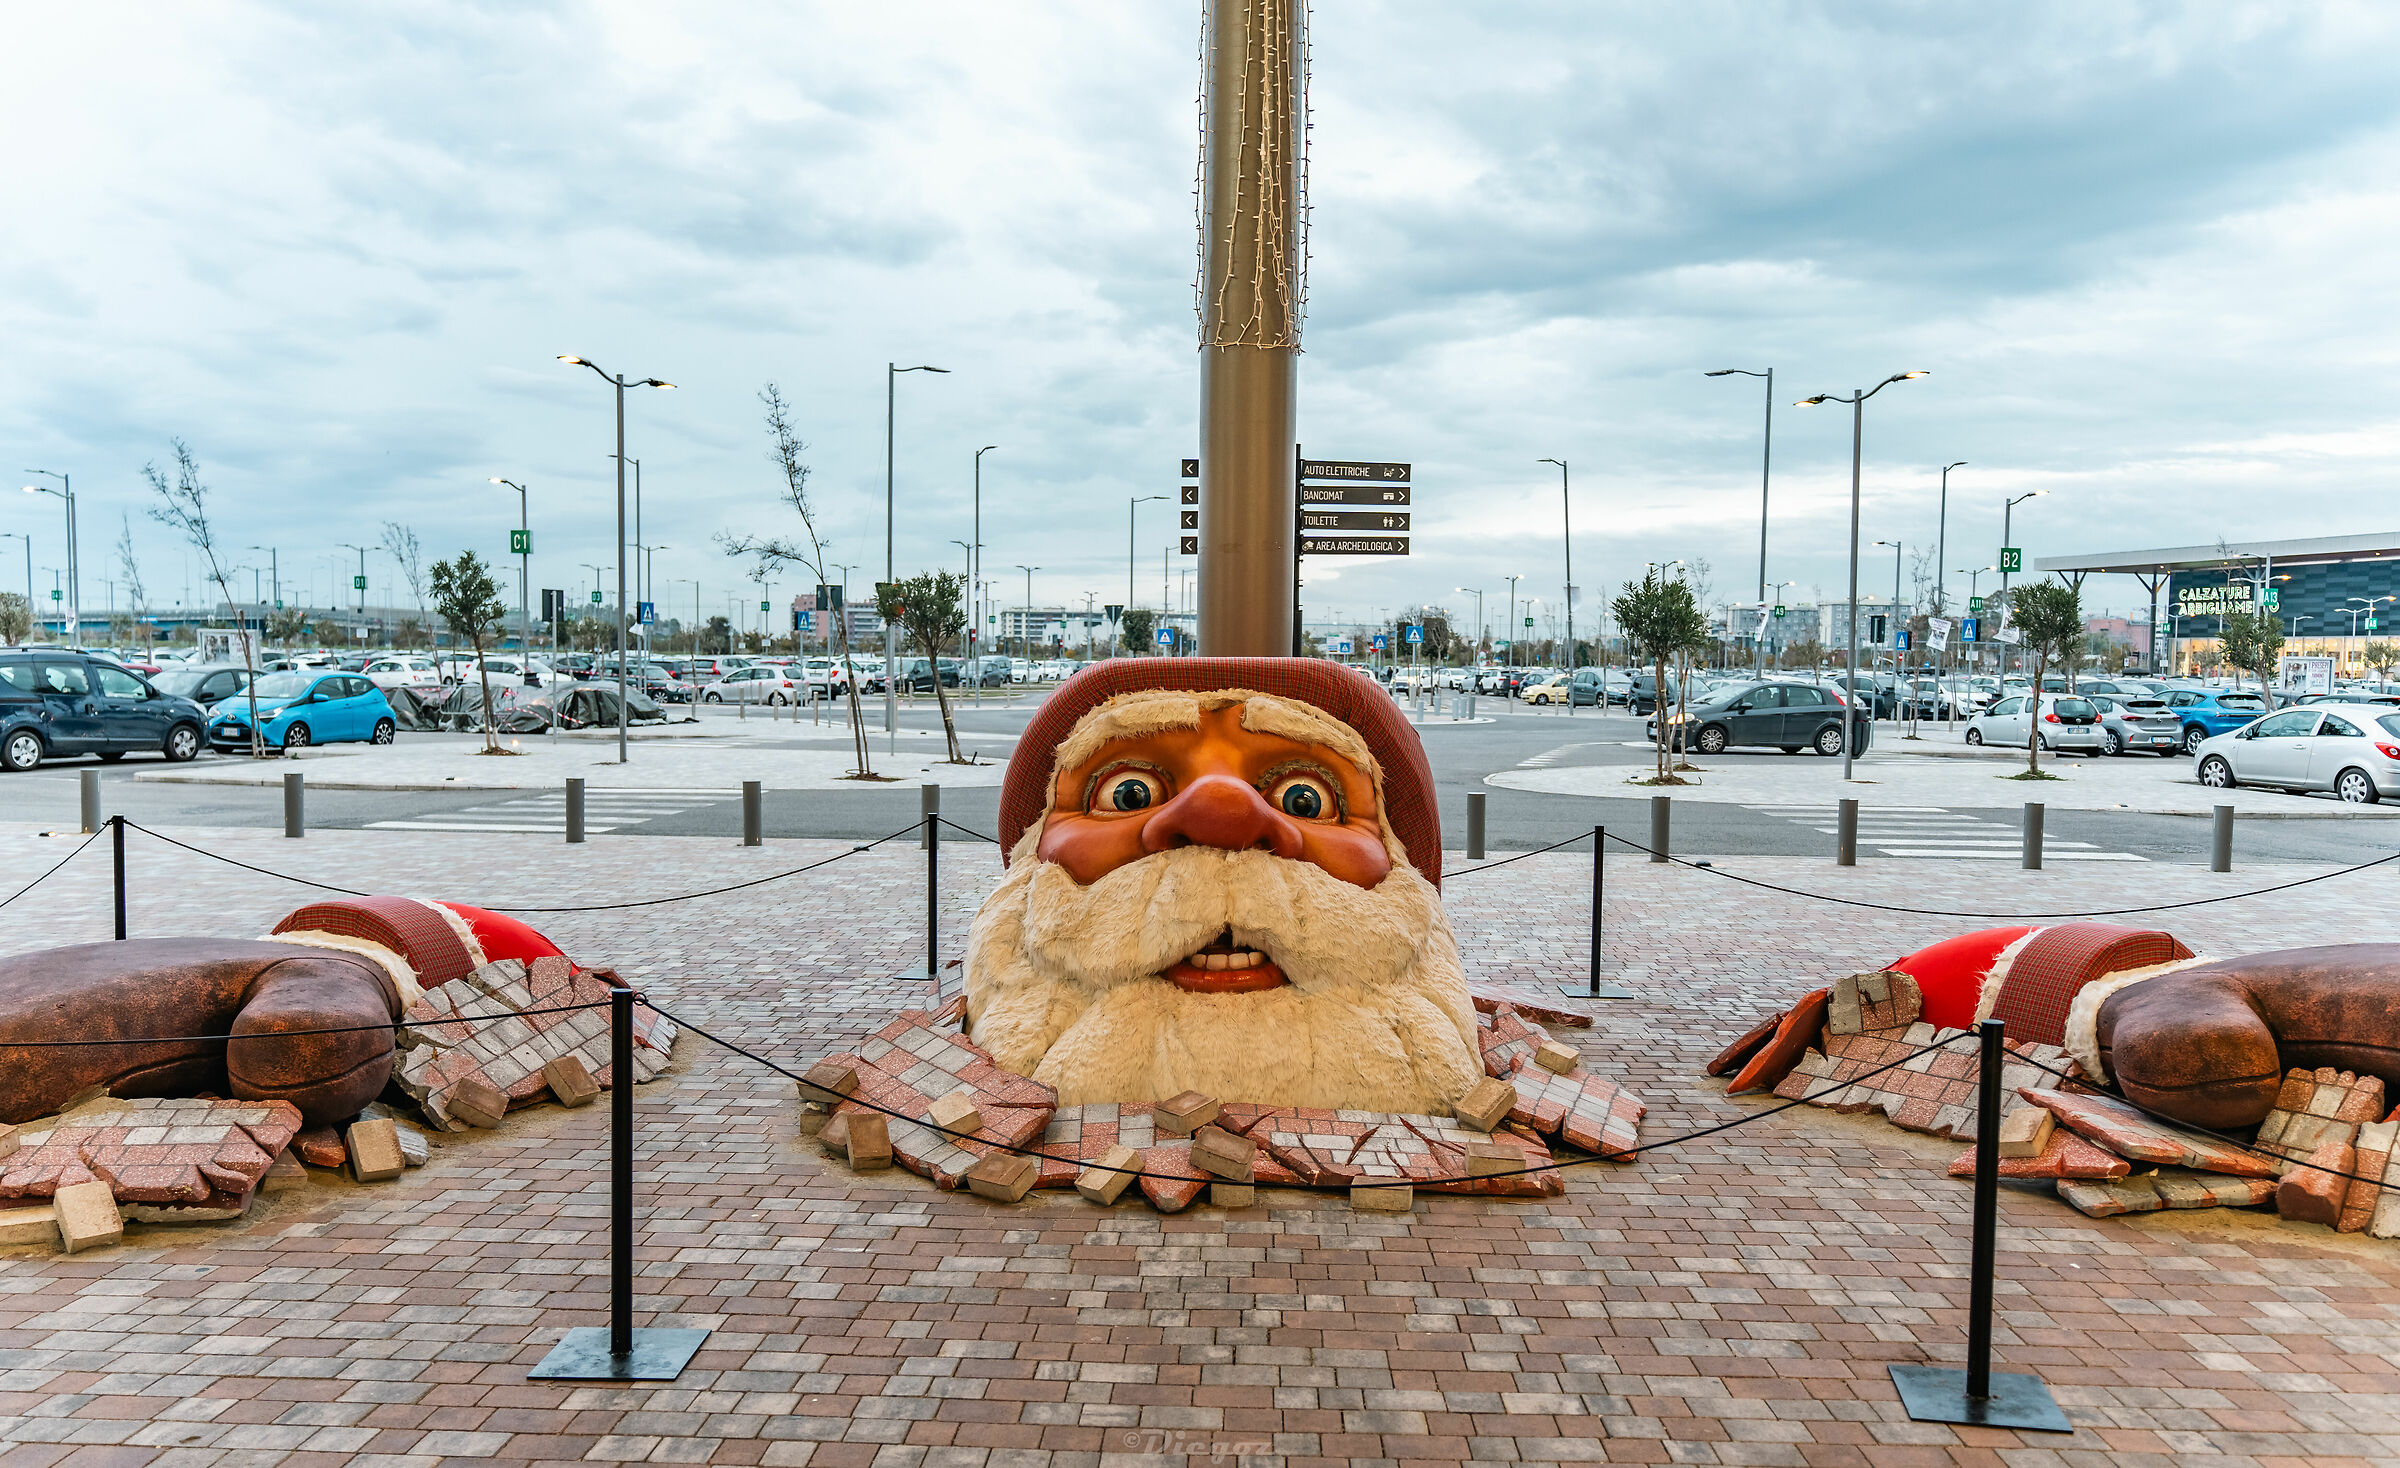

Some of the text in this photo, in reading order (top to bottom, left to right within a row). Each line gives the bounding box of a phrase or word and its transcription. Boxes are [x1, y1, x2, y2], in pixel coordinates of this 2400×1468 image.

[1304, 465, 1371, 477] AUTO ELETTRICHE
[1303, 490, 1344, 501] BANCOMAT
[1303, 515, 1339, 526] TOILETTE
[513, 533, 527, 550] C1
[1315, 541, 1393, 552] AREA ARCHEOLOGICA
[2003, 551, 2019, 568] B2
[2178, 585, 2251, 601] CALZATURE
[1970, 599, 1982, 609] A11
[1775, 607, 1784, 616] A9
